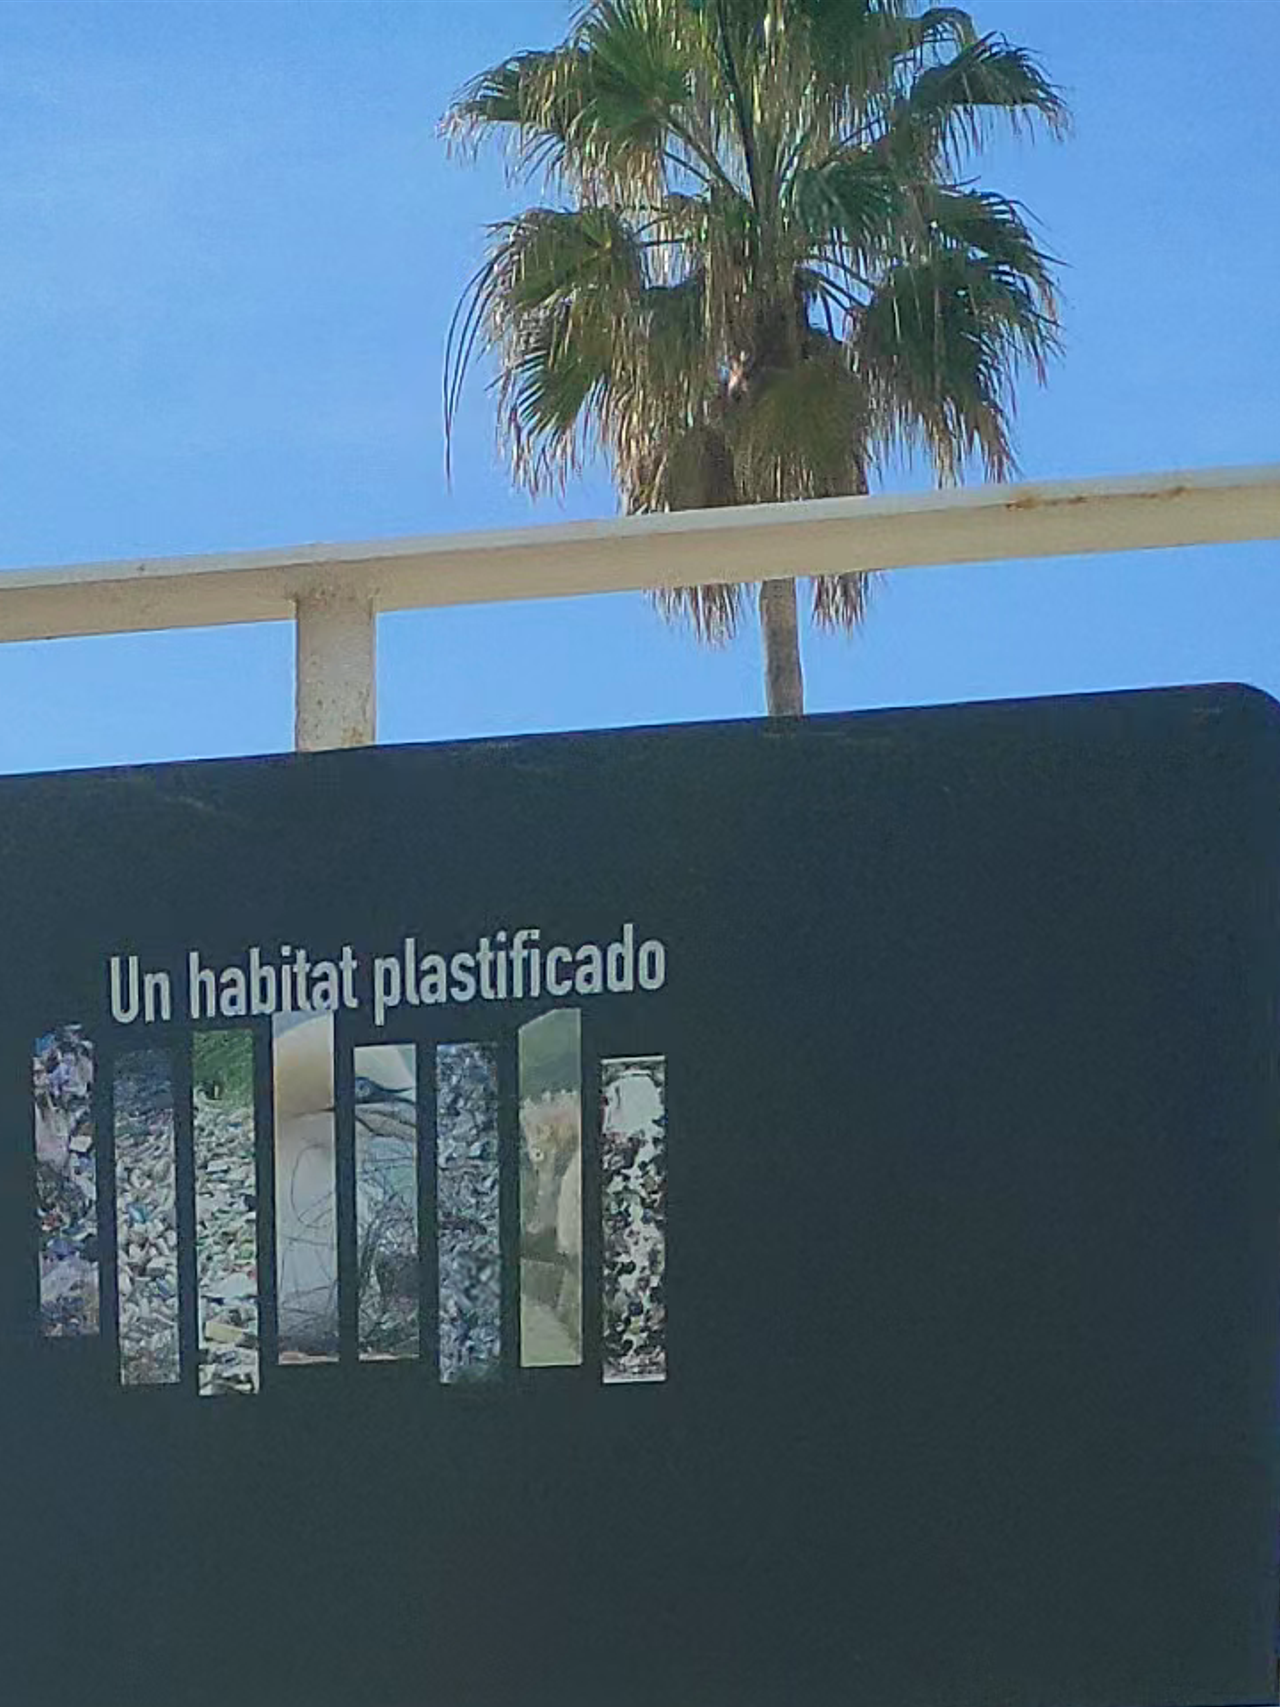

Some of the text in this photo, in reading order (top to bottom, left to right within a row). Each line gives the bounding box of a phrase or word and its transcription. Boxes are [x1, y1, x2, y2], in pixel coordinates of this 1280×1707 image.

[108, 923, 667, 1026] Un habitat plastificado
